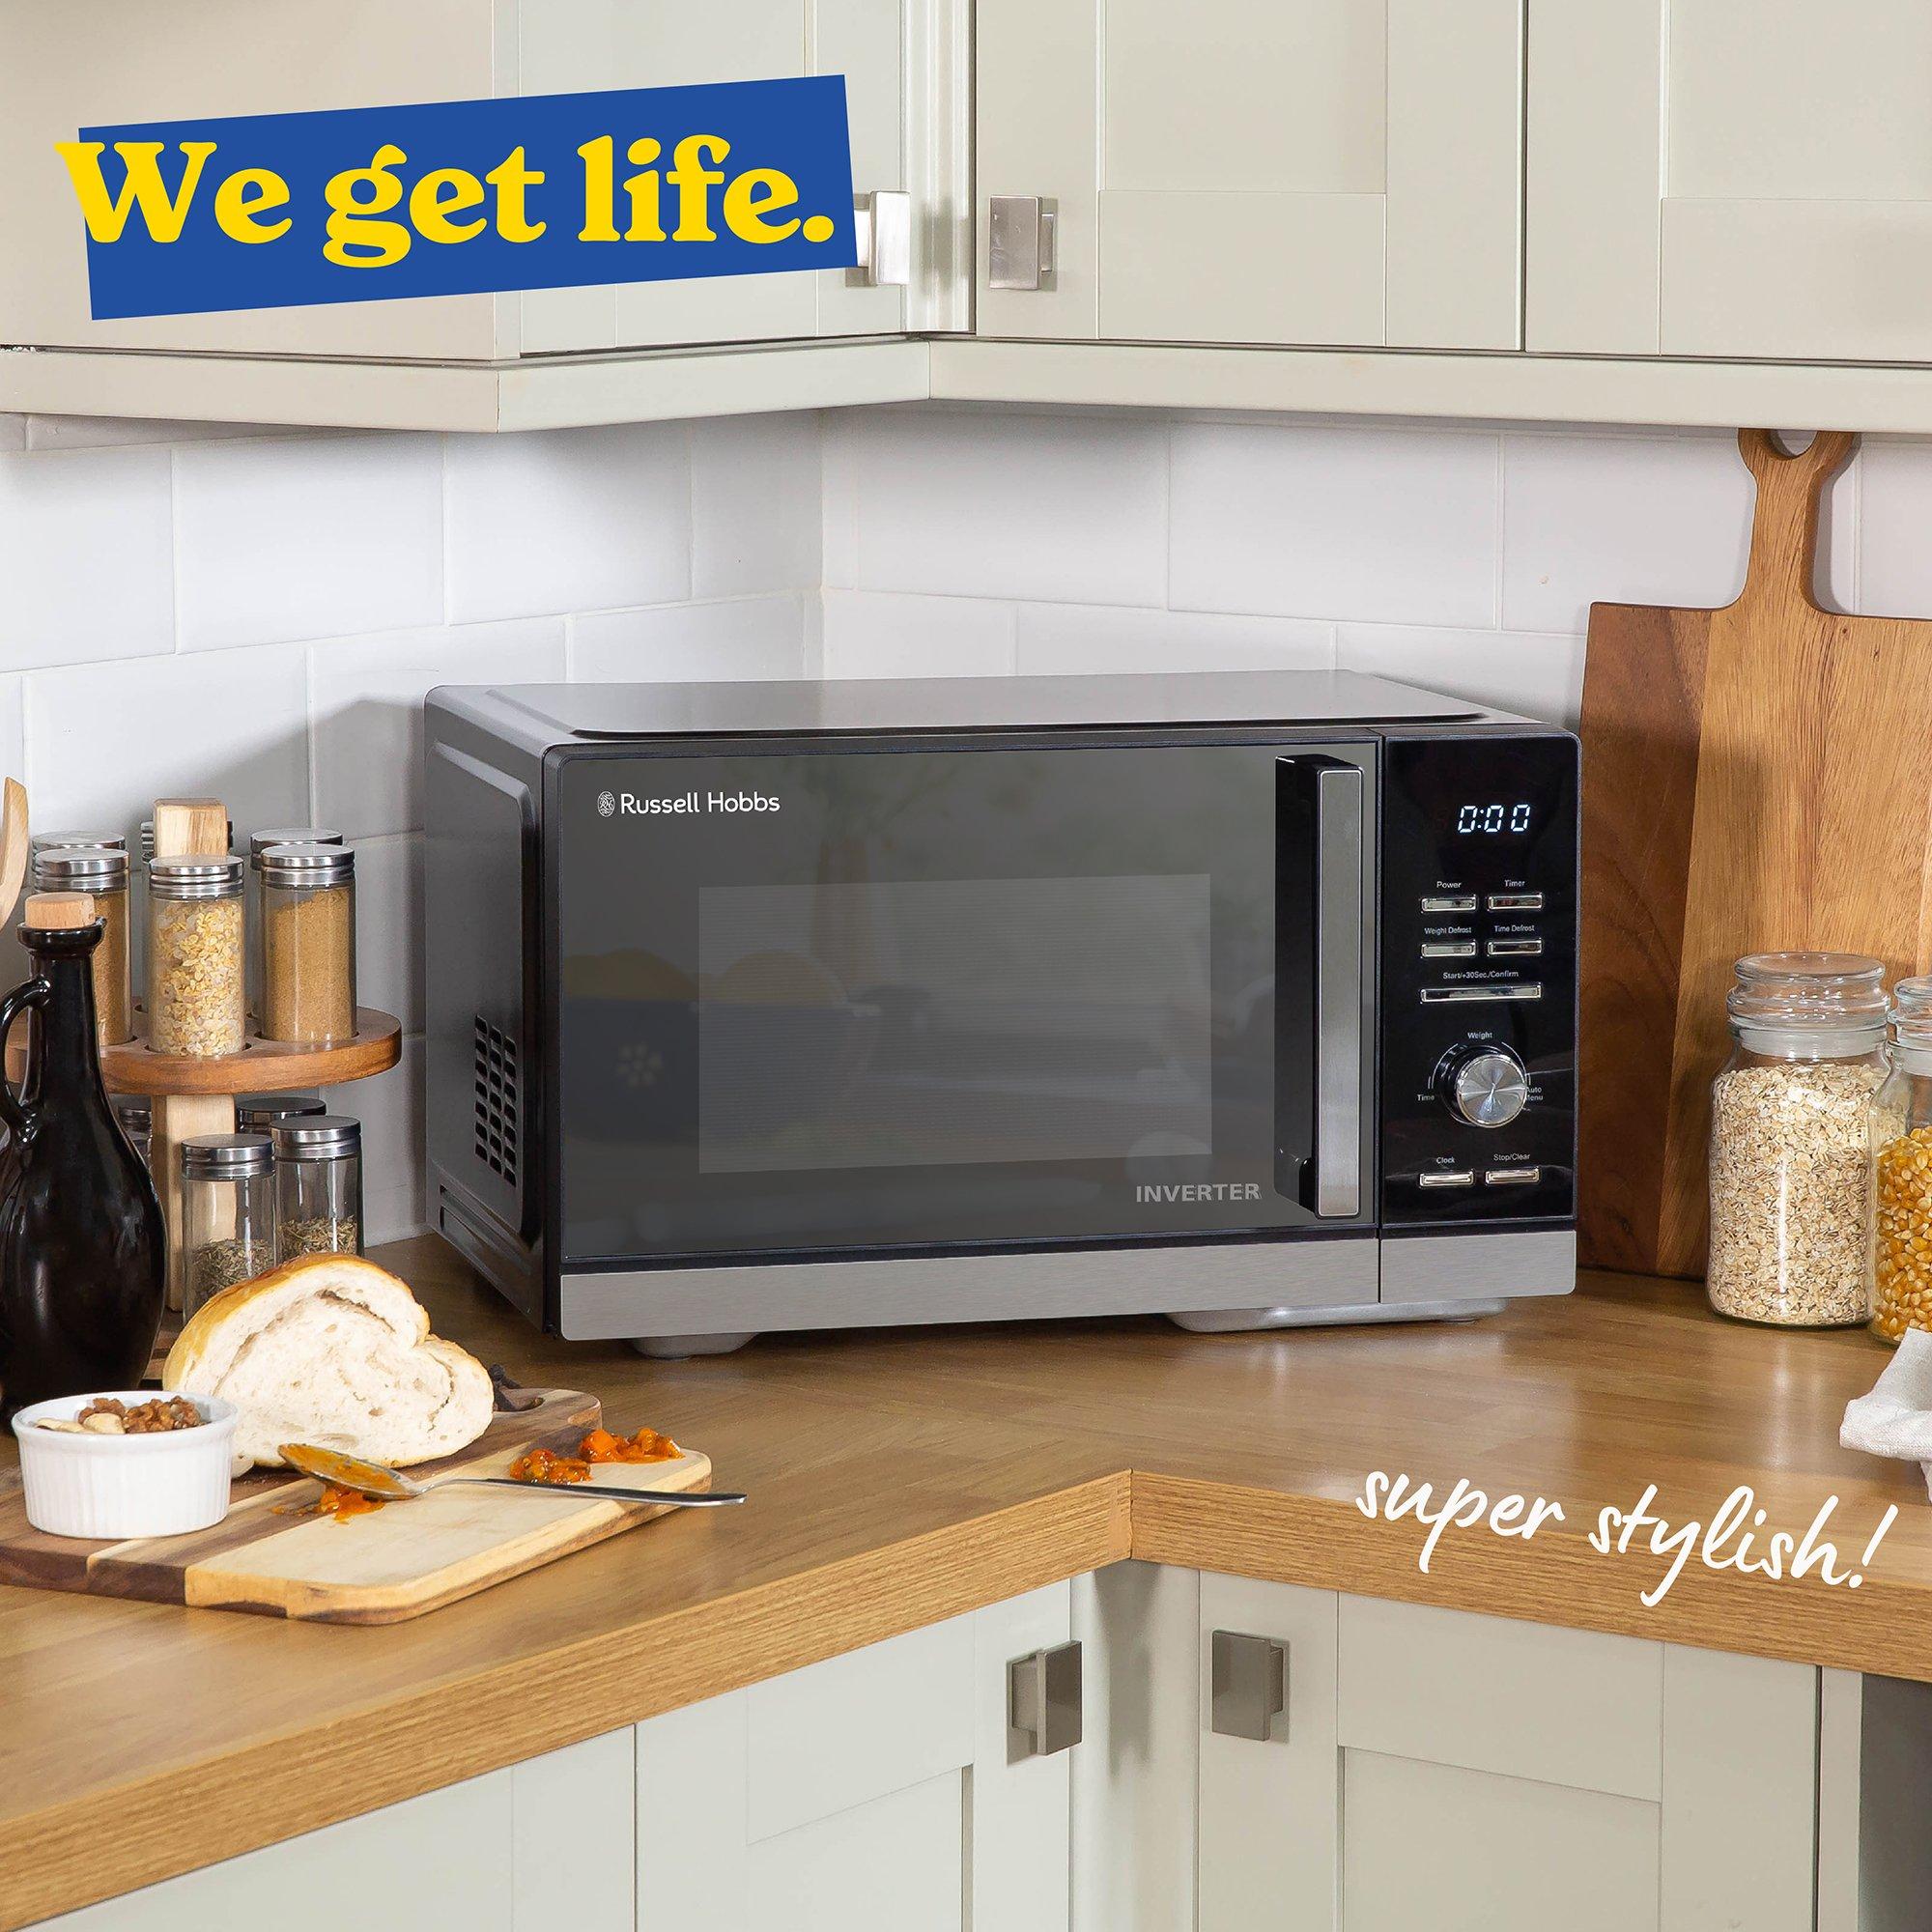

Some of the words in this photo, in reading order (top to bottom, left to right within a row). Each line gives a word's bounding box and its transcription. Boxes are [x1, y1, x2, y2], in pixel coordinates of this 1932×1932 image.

[620, 791, 700, 814] Russell
[707, 791, 781, 813] Hobbs
[1457, 804, 1531, 834] 0:00
[1504, 879, 1525, 888] Timer
[1424, 927, 1447, 936] Weight
[1467, 1031, 1492, 1041] Weight
[1435, 1156, 1456, 1165] Clock
[1493, 1152, 1531, 1162] Stop/Clear
[1136, 1183, 1263, 1203] INVERTER
